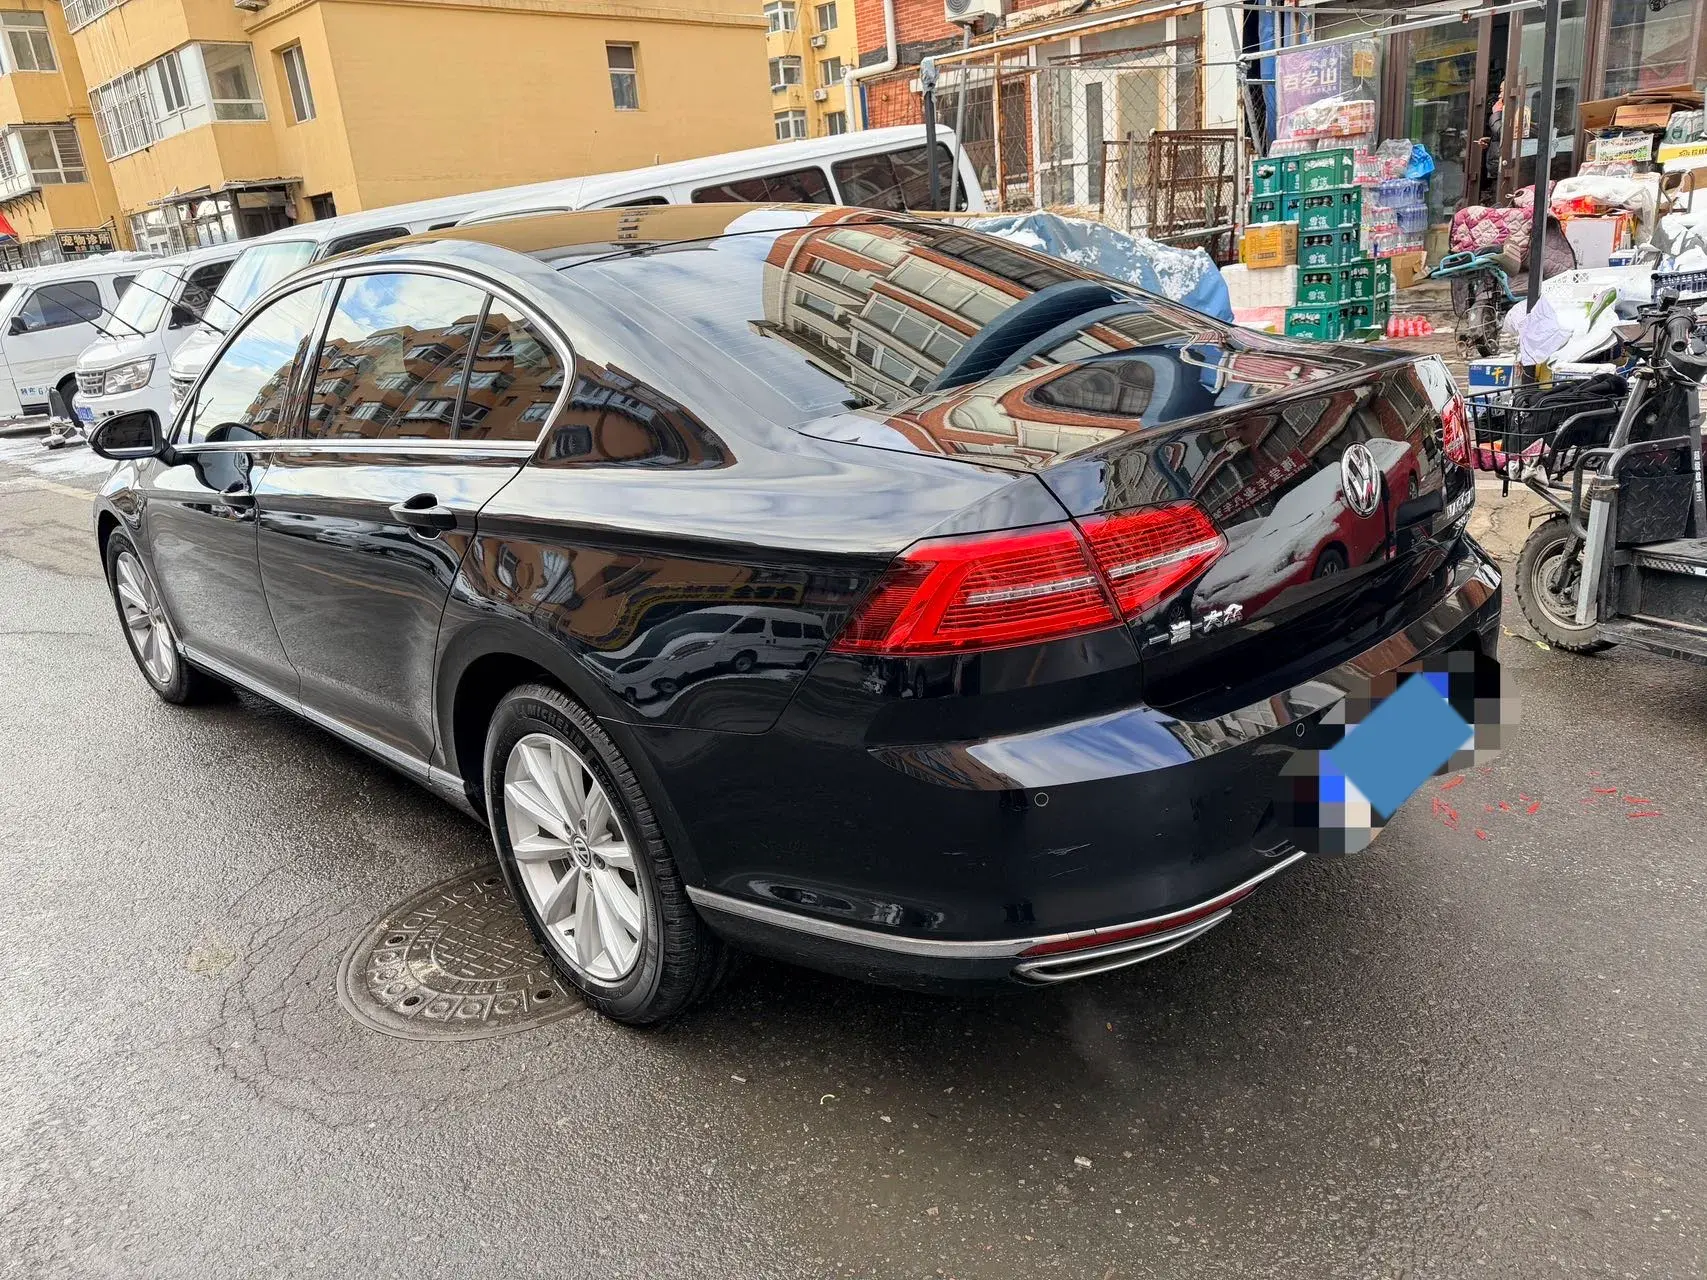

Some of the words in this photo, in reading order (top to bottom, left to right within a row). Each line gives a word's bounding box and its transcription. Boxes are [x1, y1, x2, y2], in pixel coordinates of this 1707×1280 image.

[1283, 68, 1337, 91] 百岁山
[61, 233, 110, 246] 宠物诊所
[527, 704, 586, 752] MICHELIN
